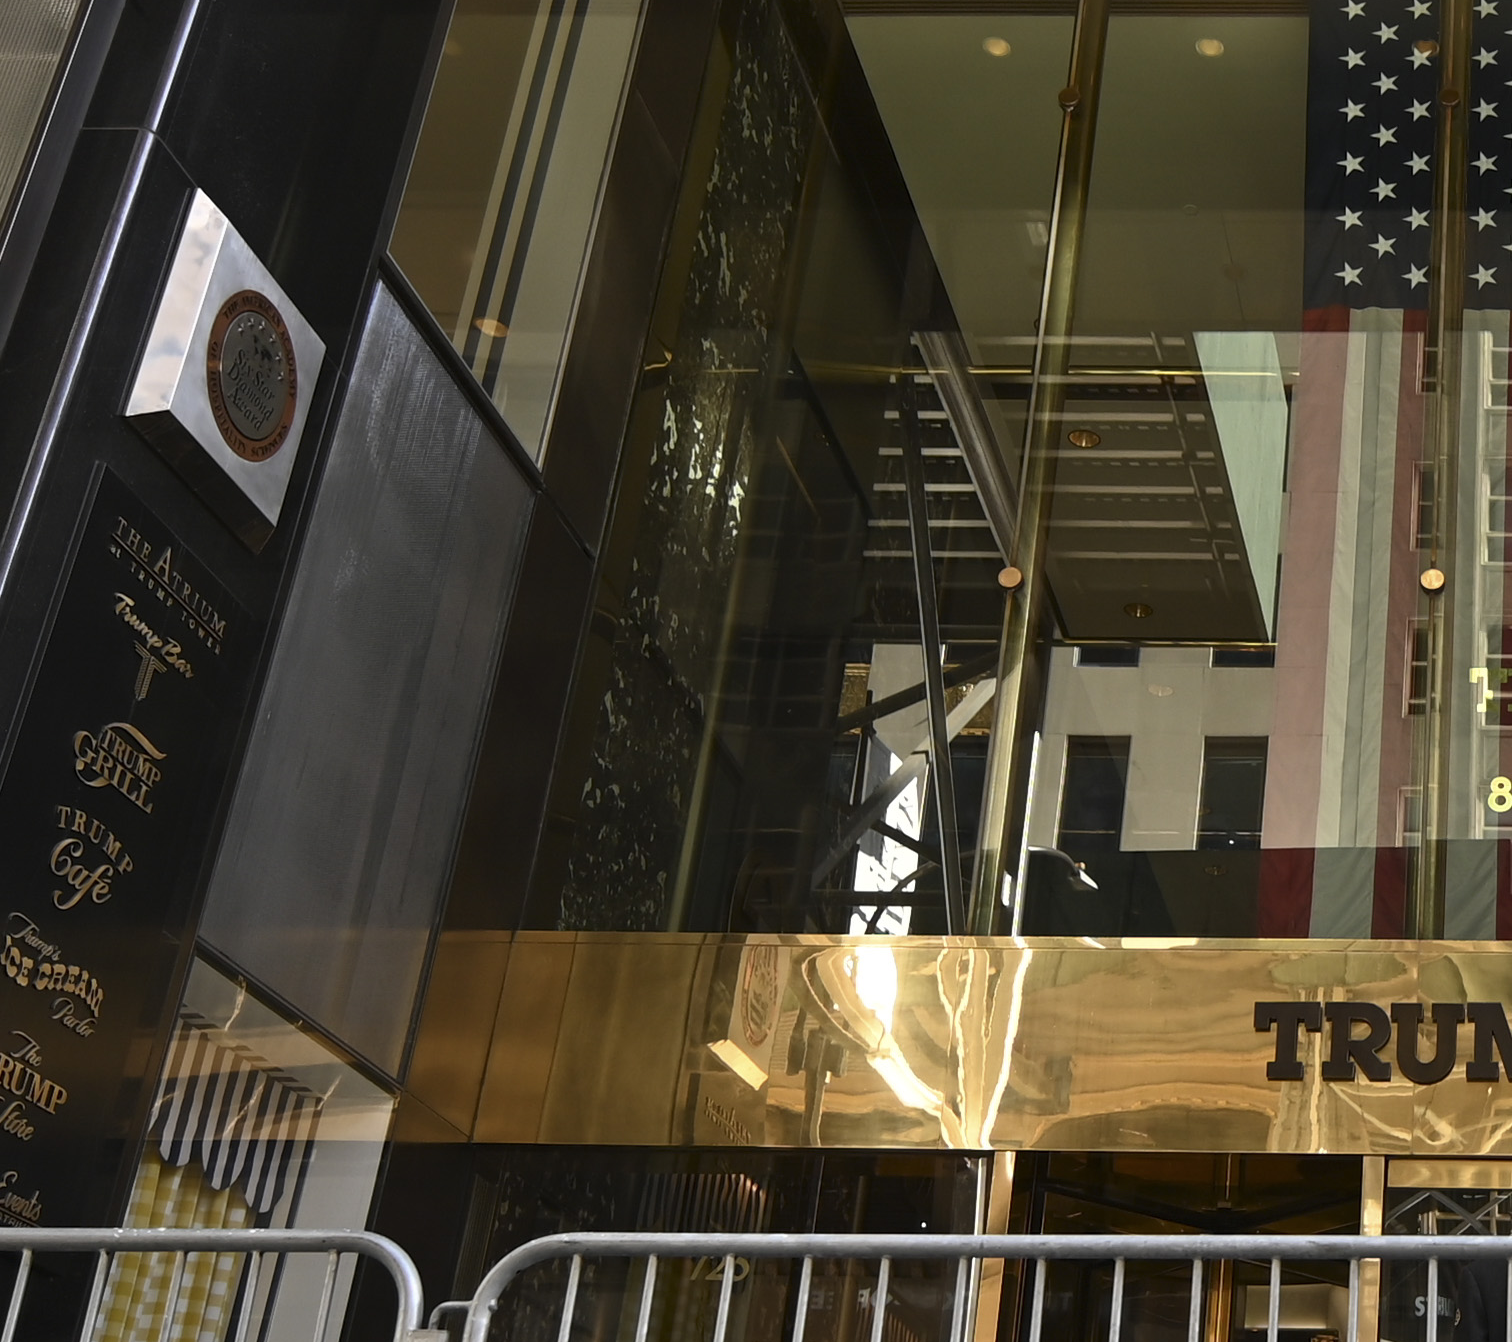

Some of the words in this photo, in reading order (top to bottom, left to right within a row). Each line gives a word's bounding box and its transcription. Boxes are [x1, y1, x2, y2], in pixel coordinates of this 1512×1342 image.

[118, 516, 152, 562] THE
[153, 547, 227, 638] ATRIUM
[130, 561, 174, 607] TRUMP
[181, 611, 221, 655] TOWER
[114, 592, 163, 649] Trump
[160, 637, 194, 678] Bar
[73, 730, 154, 814] GRILL
[99, 723, 165, 788] TRUMP
[50, 838, 114, 910] Café
[56, 805, 135, 875] TRUMP
[7, 911, 61, 961] Trump's
[0, 935, 34, 988] ICE
[35, 963, 105, 1018] CREAM
[9, 1030, 42, 1067] The
